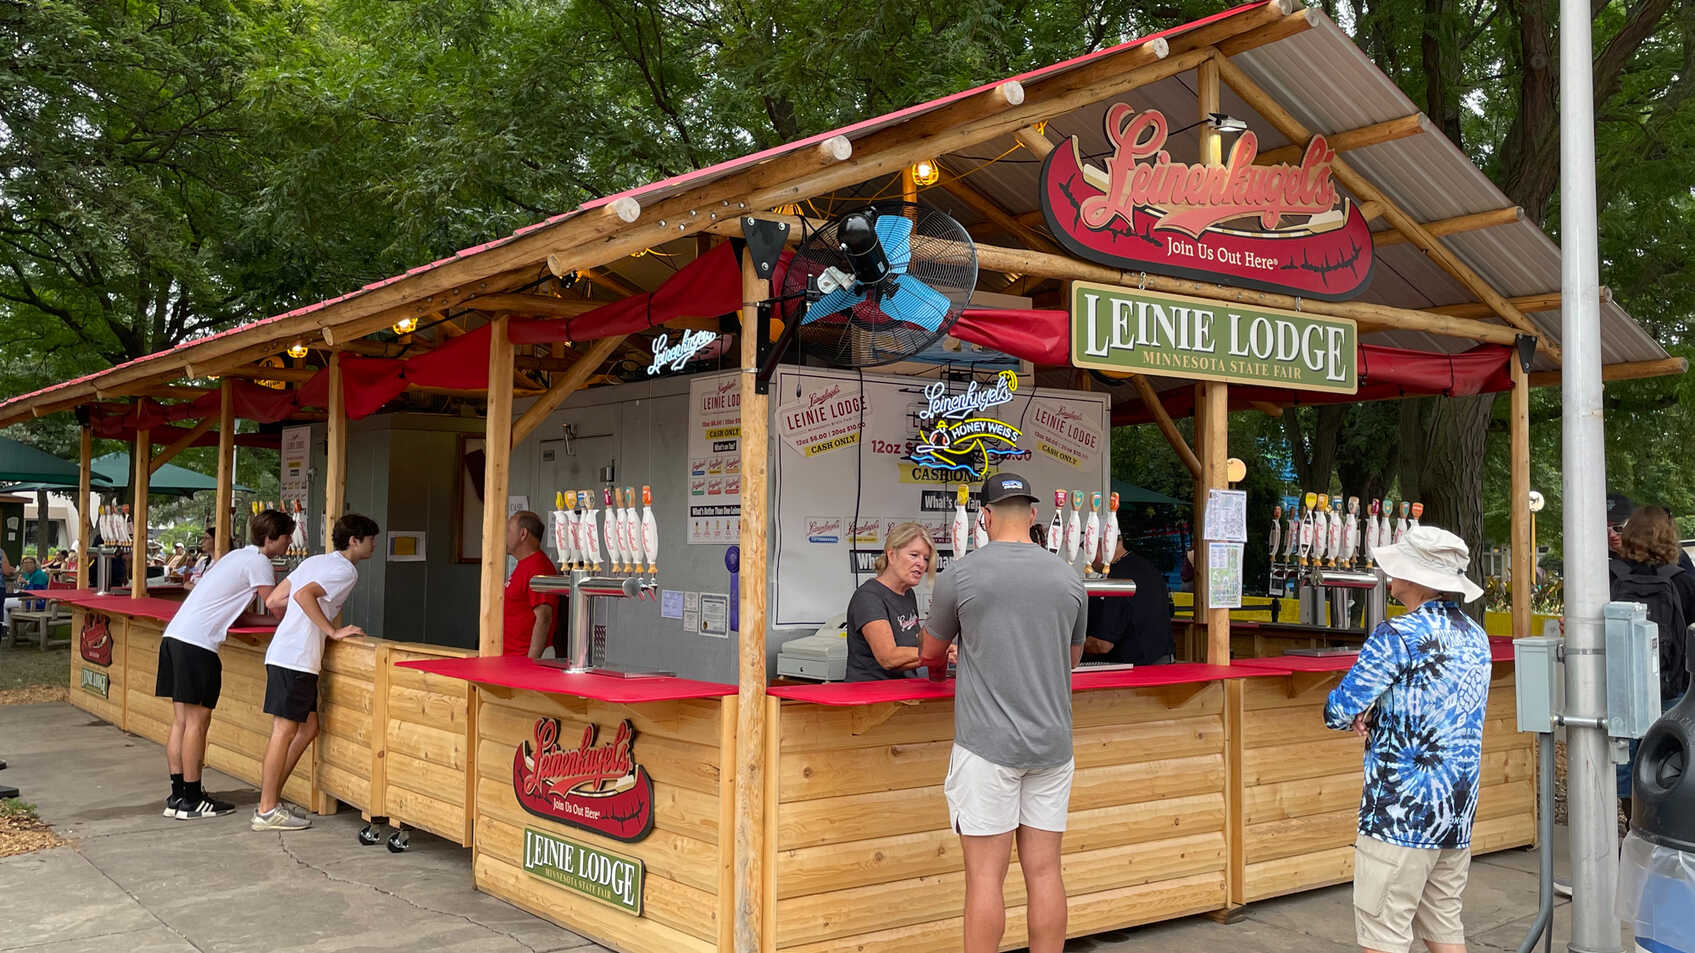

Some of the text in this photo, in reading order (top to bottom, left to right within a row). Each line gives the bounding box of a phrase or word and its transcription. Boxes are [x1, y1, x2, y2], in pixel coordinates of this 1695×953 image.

[1080, 103, 1338, 238] Leinenkugel's
[1167, 237, 1194, 257] Join
[1198, 243, 1214, 261] Us
[1217, 247, 1242, 266] Out
[1084, 293, 1347, 382] LEINIE LODGE
[1143, 350, 1303, 380] MINNESOTA STATE FAIR
[703, 395, 725, 411] LEINIE
[919, 376, 1013, 419] Leinenkugel's
[787, 407, 828, 431] LEINIE
[830, 395, 868, 419] LODGE
[951, 421, 987, 440] HONEY
[988, 421, 1019, 443] WEISS
[1035, 408, 1097, 449] LEINIE LODGE
[811, 434, 856, 454] CASH ONLY
[872, 440, 901, 455] 12oz
[925, 494, 953, 510] What's
[524, 719, 631, 799] Leinenkugel's
[553, 798, 564, 811] Join
[565, 802, 573, 813] Us
[573, 804, 584, 816] Out
[525, 831, 635, 906] LEINIE LODGE
